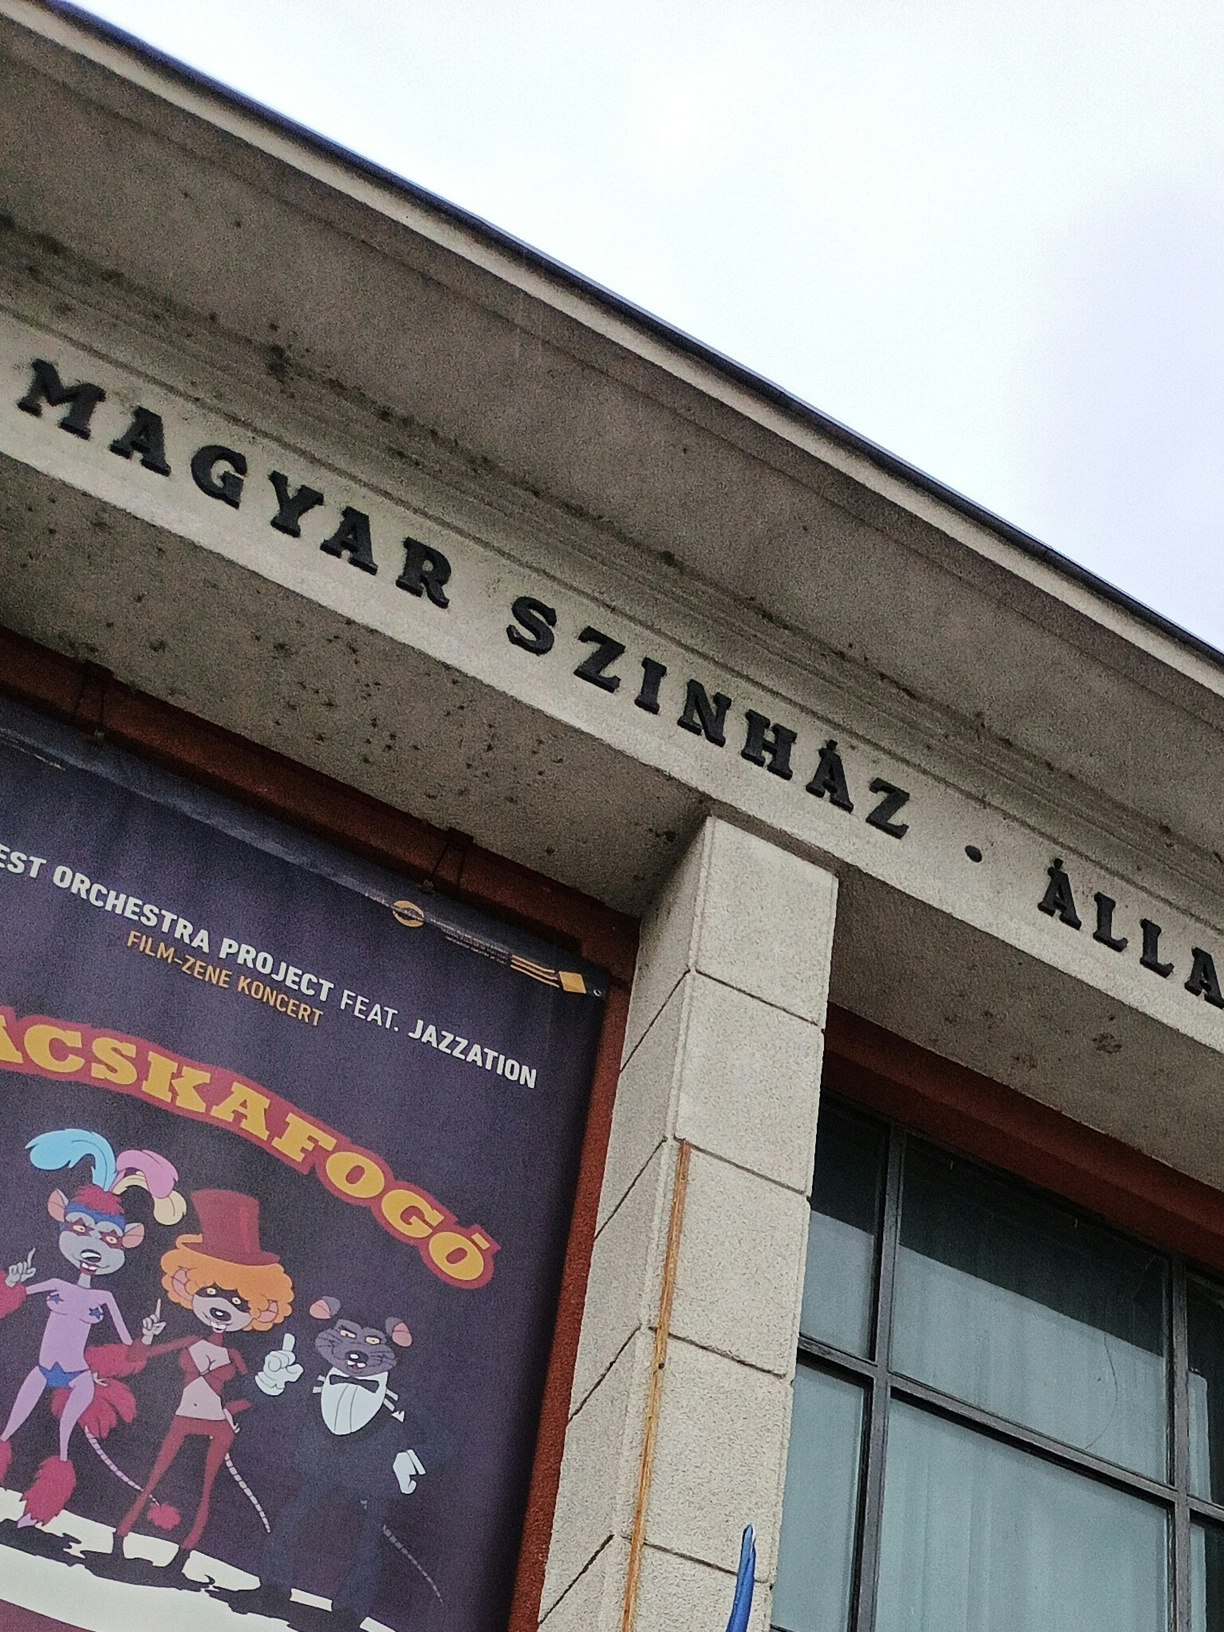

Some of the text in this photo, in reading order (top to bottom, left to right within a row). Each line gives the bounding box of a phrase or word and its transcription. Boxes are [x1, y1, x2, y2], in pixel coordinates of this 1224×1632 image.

[17, 358, 451, 608] MAGYAR
[53, 865, 210, 954] ORCHESTRA
[219, 937, 334, 1002] PROJECT
[340, 989, 399, 1032] FEAT.
[408, 1019, 538, 1089] JAZZATION
[127, 930, 324, 1027] FILM-ZENE KONCERT
